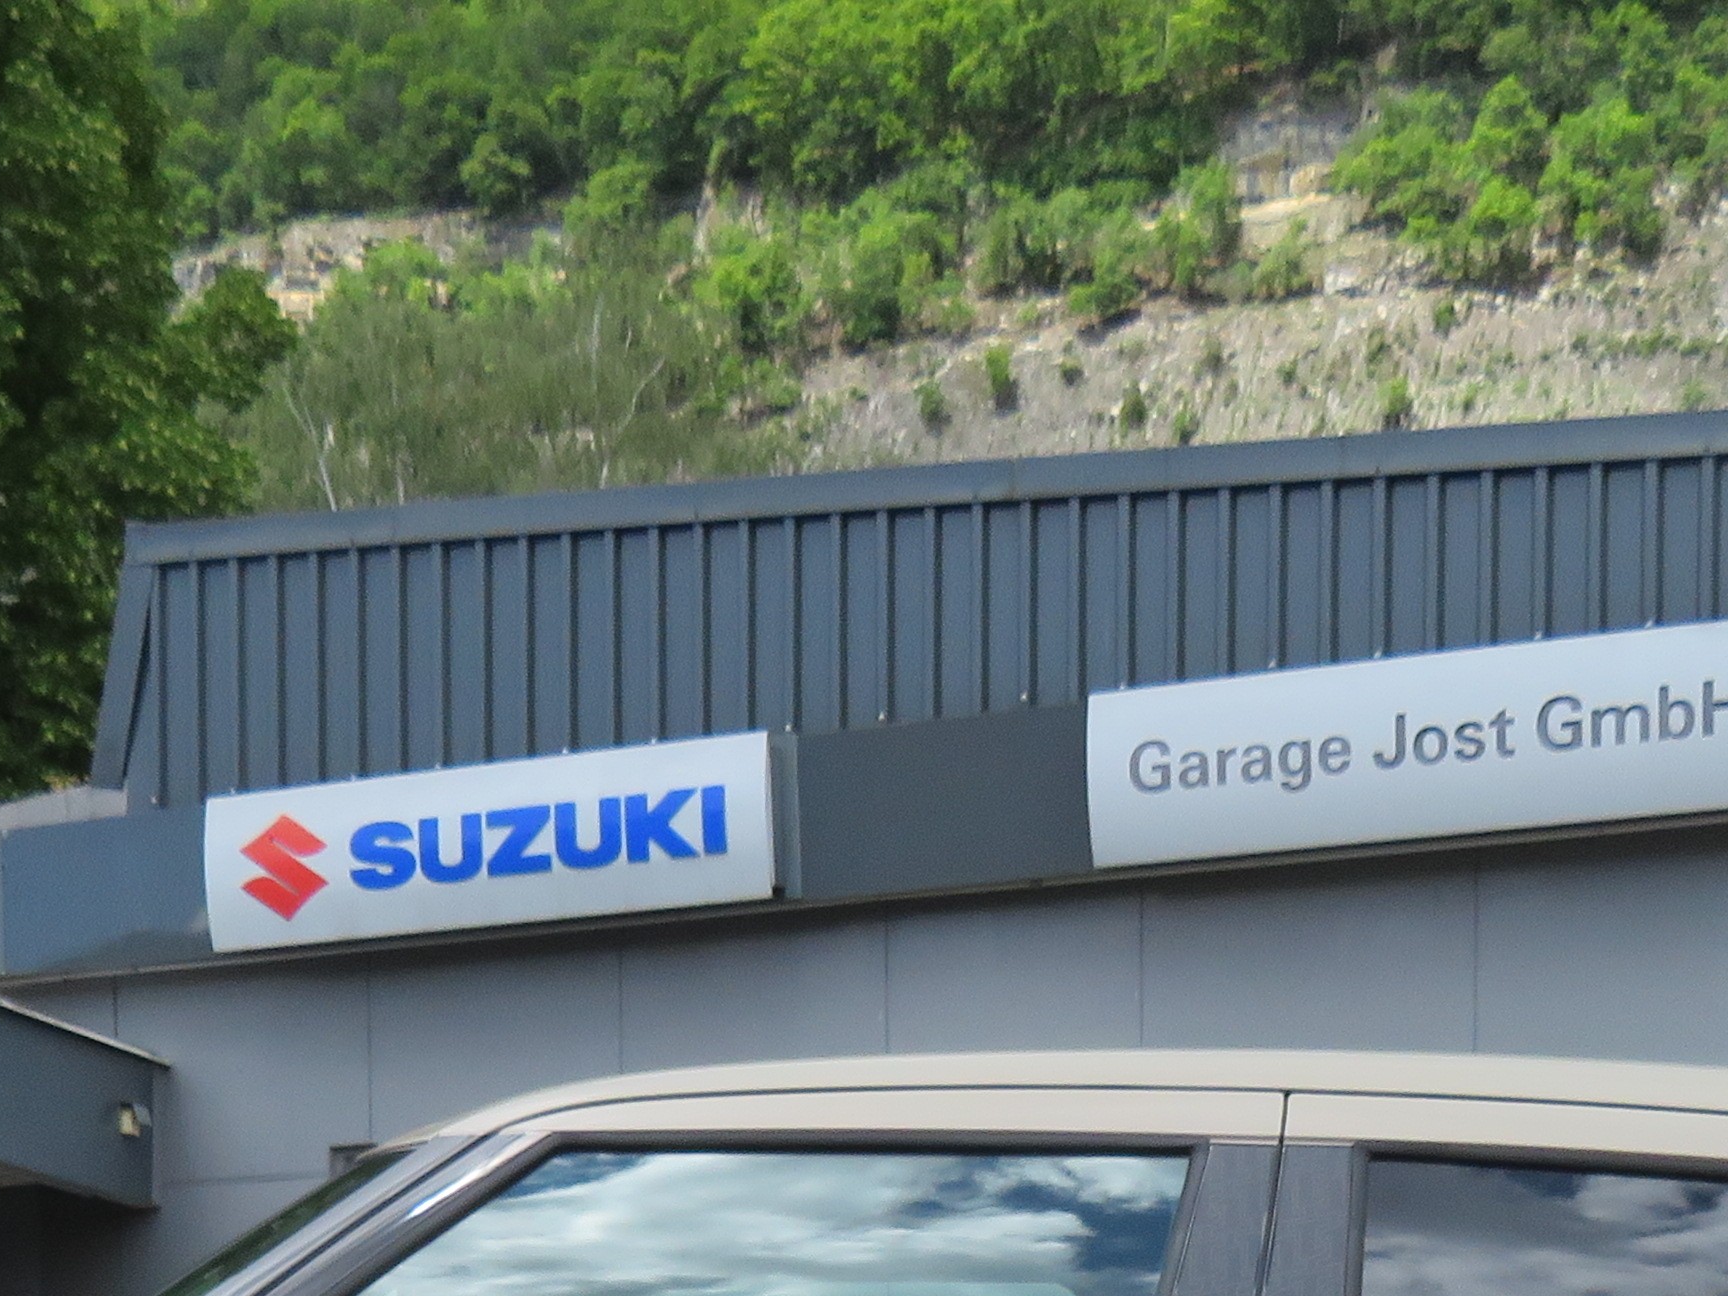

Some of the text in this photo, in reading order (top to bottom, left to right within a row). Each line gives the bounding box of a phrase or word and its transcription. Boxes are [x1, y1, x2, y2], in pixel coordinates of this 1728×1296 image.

[1128, 733, 1352, 794] Garage
[1373, 708, 1516, 770] Jost
[349, 785, 728, 891] SUZUKI
